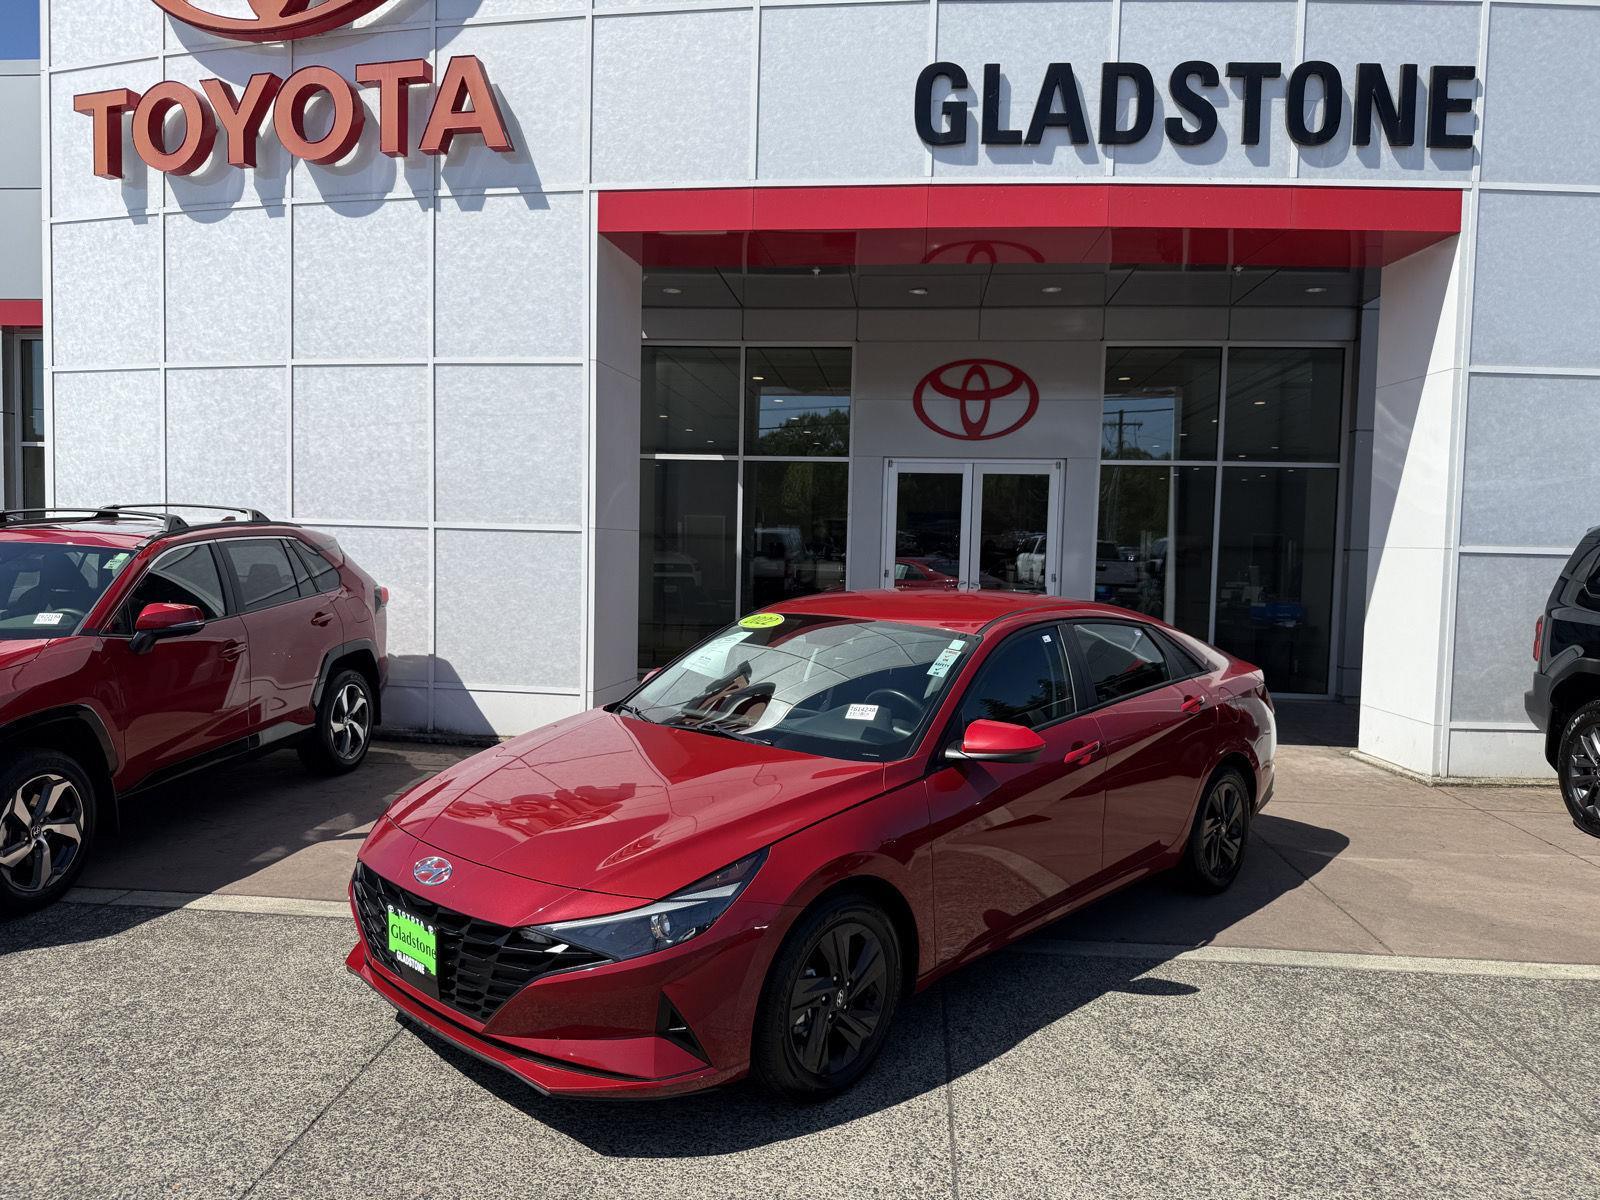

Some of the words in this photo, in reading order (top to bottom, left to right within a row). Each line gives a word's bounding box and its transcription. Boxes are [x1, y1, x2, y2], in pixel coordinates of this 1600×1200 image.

[73, 55, 515, 180] TOYOTA
[914, 60, 1477, 149] GLADSTONE
[397, 908, 424, 928] TOYOTA
[391, 924, 436, 960] Gladstone
[396, 950, 425, 974] GLADSTONE
